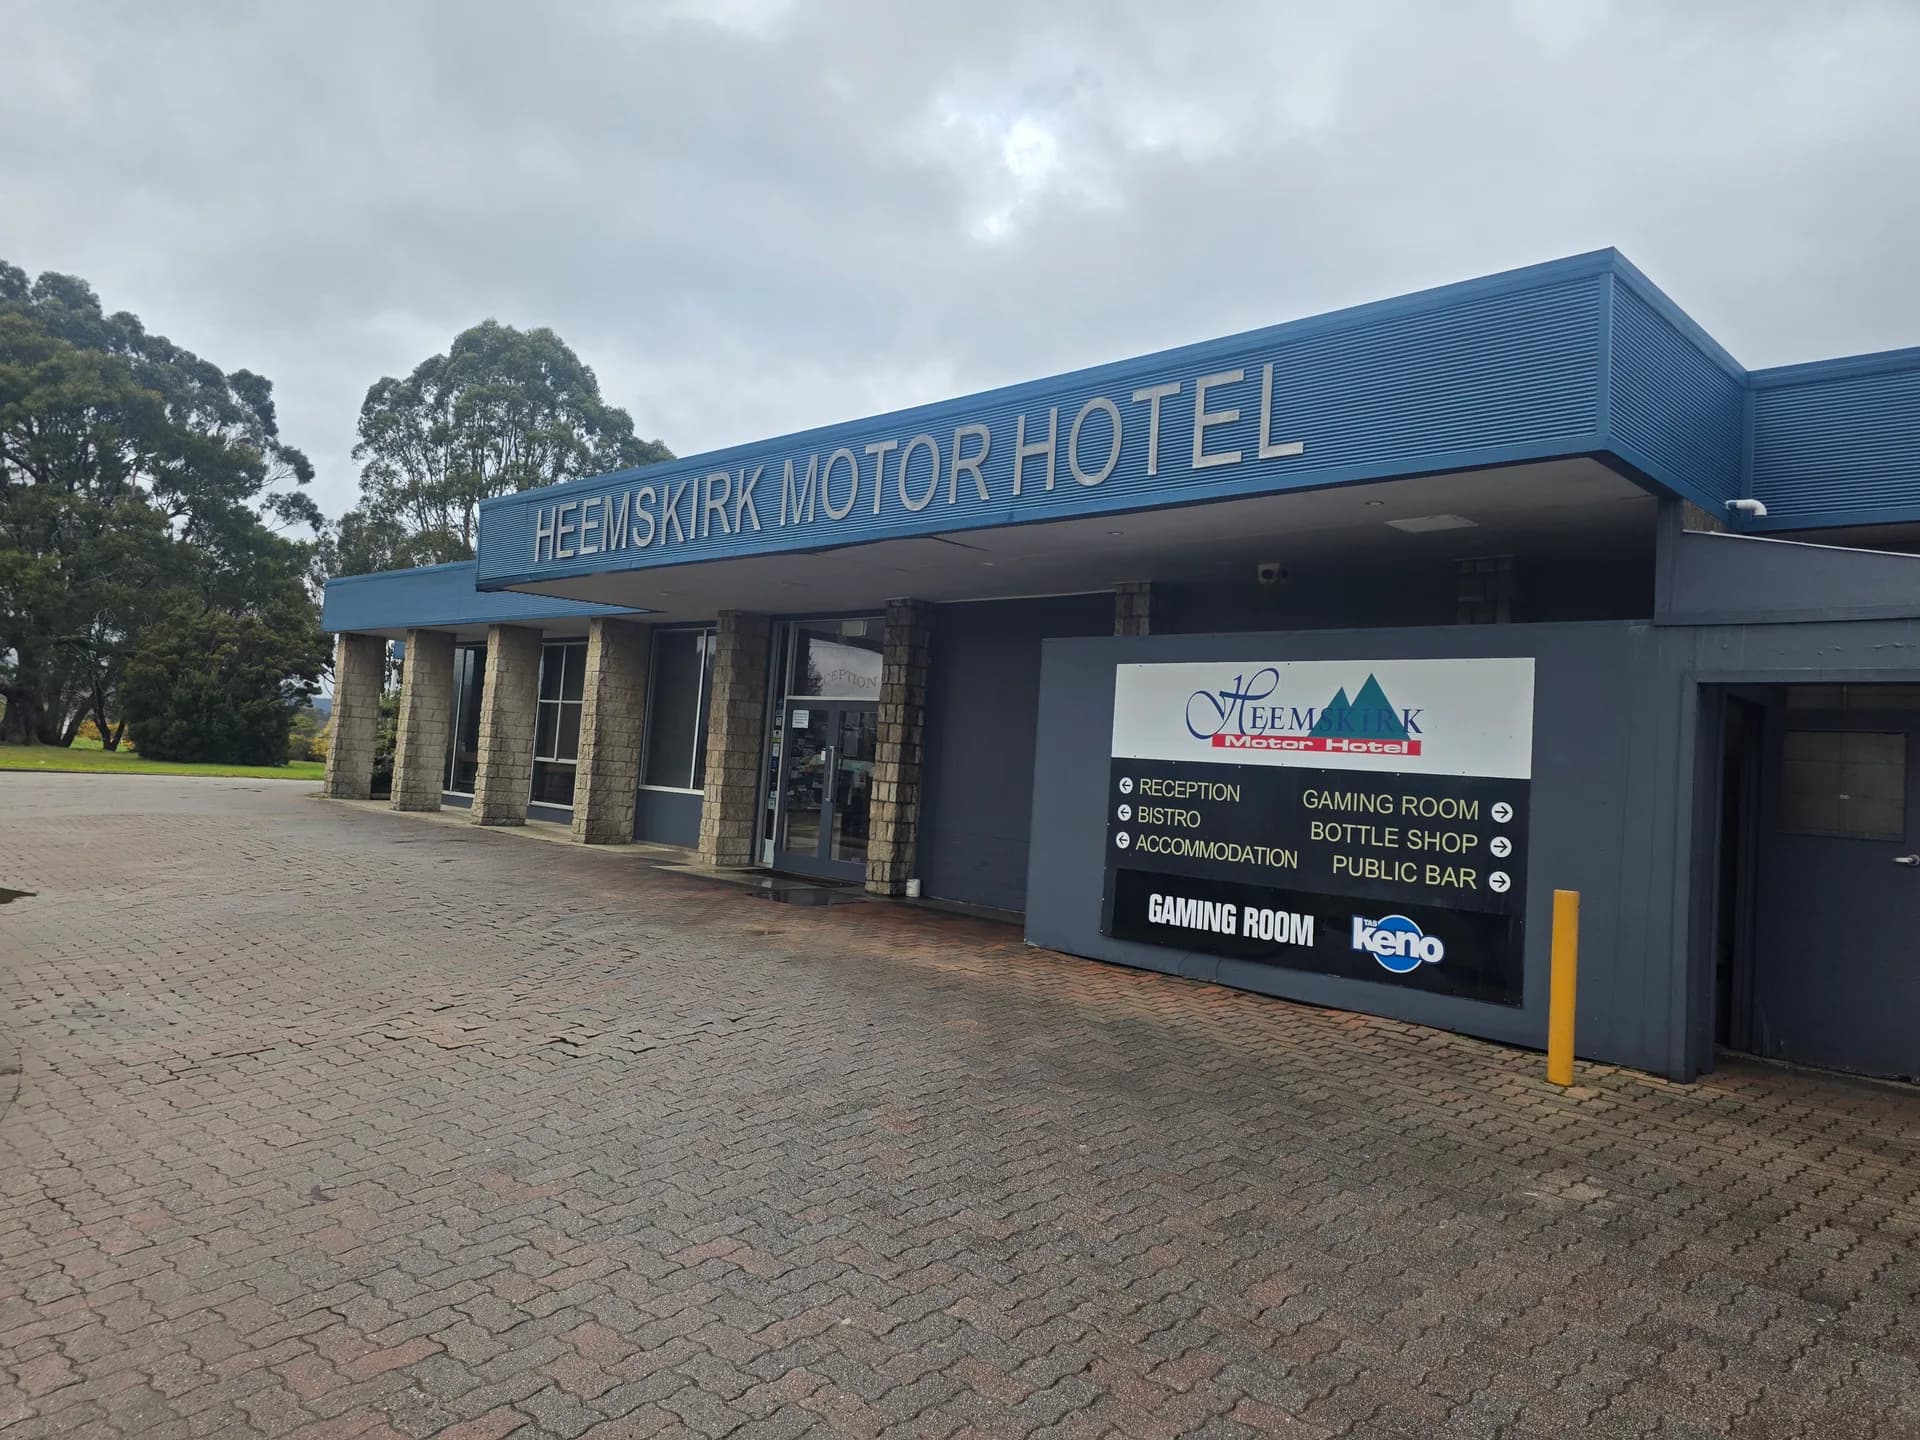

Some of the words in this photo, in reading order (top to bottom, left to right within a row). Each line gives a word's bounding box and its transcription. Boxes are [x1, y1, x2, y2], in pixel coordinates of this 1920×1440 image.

[534, 464, 764, 562] HEEMSKIRK
[780, 424, 991, 527] MOTOR
[1012, 363, 1304, 496] HOTEL
[1185, 667, 1424, 740] HEEMSKIRK
[1224, 735, 1314, 750] Motor
[1325, 738, 1409, 754] Hotel
[1139, 778, 1241, 803] RECEPTION
[1302, 789, 1394, 815] GAMING
[1401, 796, 1479, 821] ROOM
[1138, 807, 1201, 829] BISTRO
[1135, 834, 1298, 869] ACCOMMODATION
[1311, 821, 1399, 848] BOTTLE
[1406, 829, 1479, 855] SHOP
[1332, 855, 1418, 884] PUBLIC
[1425, 864, 1477, 890] BAR
[1149, 893, 1237, 936] GAMING
[1243, 906, 1314, 947] ROOM
[1363, 918, 1378, 927] TAS
[1352, 916, 1444, 963] keno
